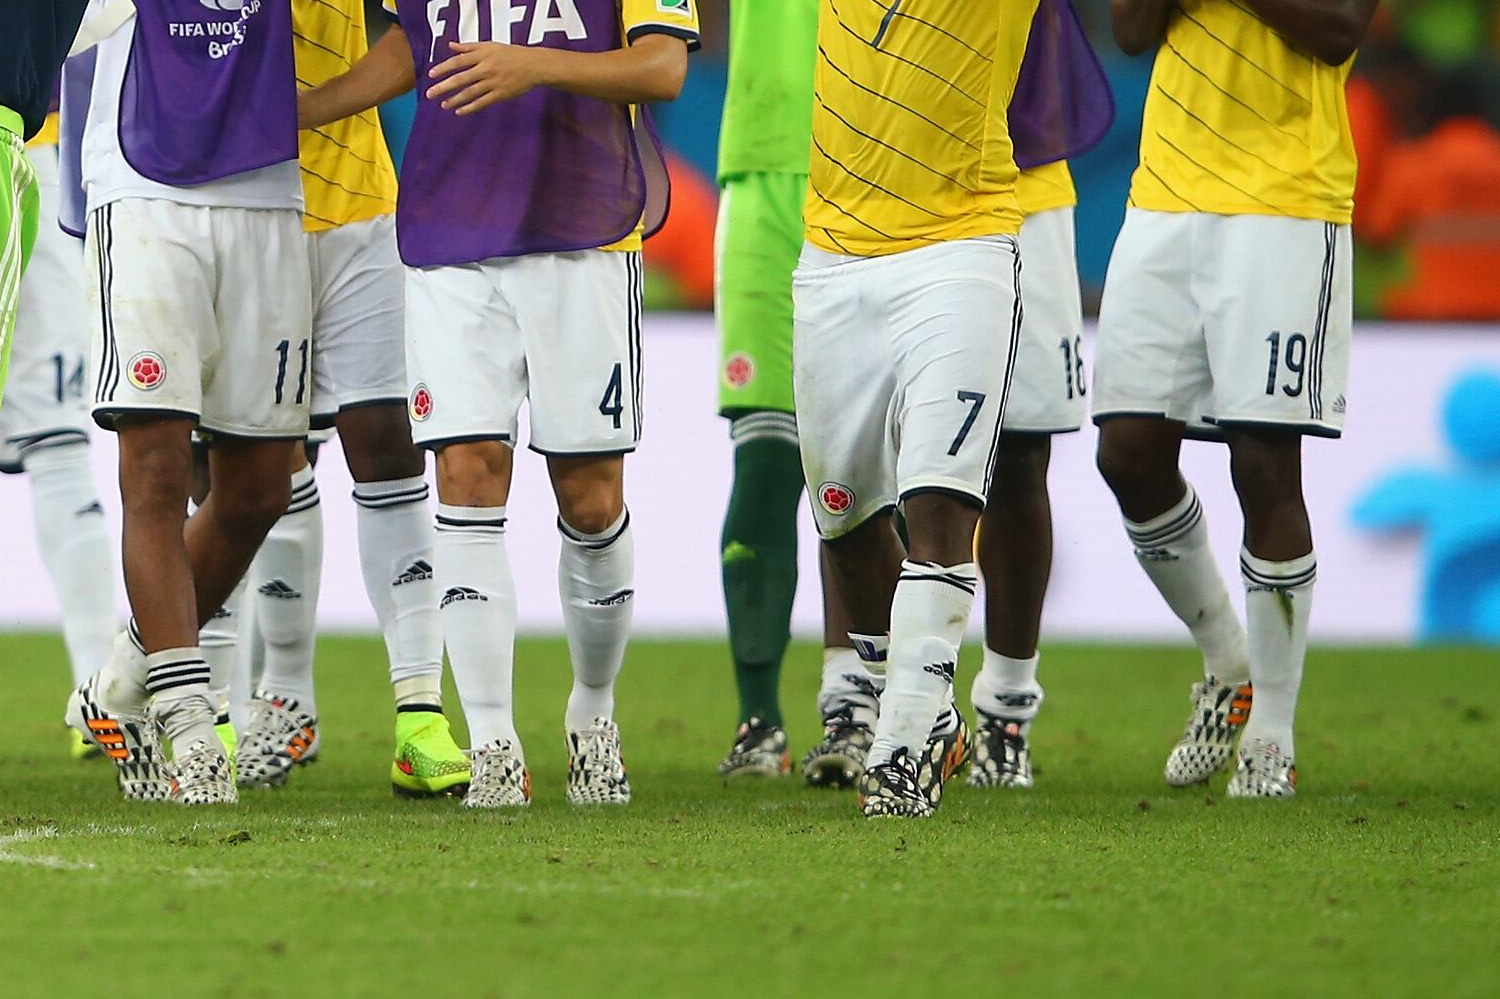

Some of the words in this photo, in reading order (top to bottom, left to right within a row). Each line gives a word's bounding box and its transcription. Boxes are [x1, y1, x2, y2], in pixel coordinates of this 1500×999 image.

[169, 24, 205, 36] FIFA
[275, 338, 308, 404] 11
[599, 363, 623, 428] 4
[1265, 330, 1306, 397] 19
[947, 390, 986, 456] 7
